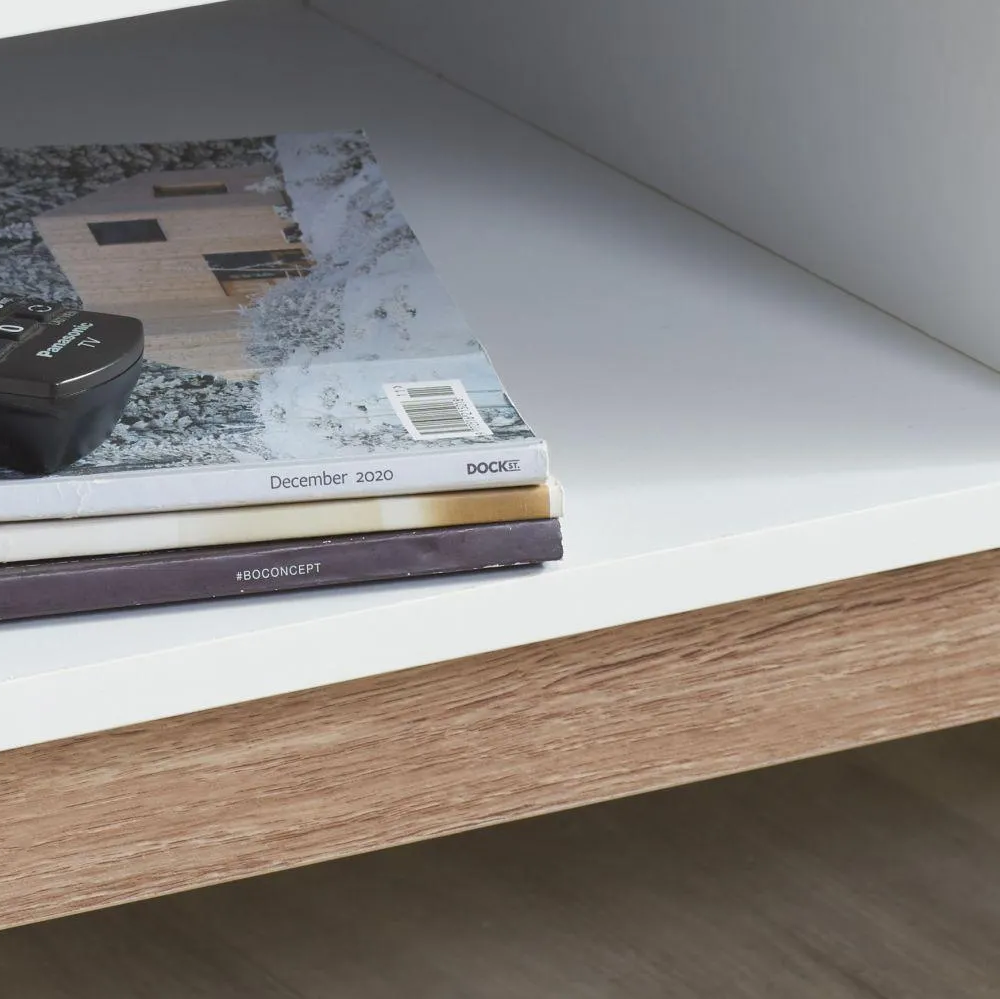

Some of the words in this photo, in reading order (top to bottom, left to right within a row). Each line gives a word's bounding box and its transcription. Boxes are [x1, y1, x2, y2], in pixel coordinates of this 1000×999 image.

[36, 322, 93, 357] Panasonic
[77, 336, 101, 348] TV
[466, 460, 508, 475] DOCK
[270, 470, 348, 490] December
[355, 469, 394, 484] 2020
[236, 563, 321, 582] #BOCONCEPT
